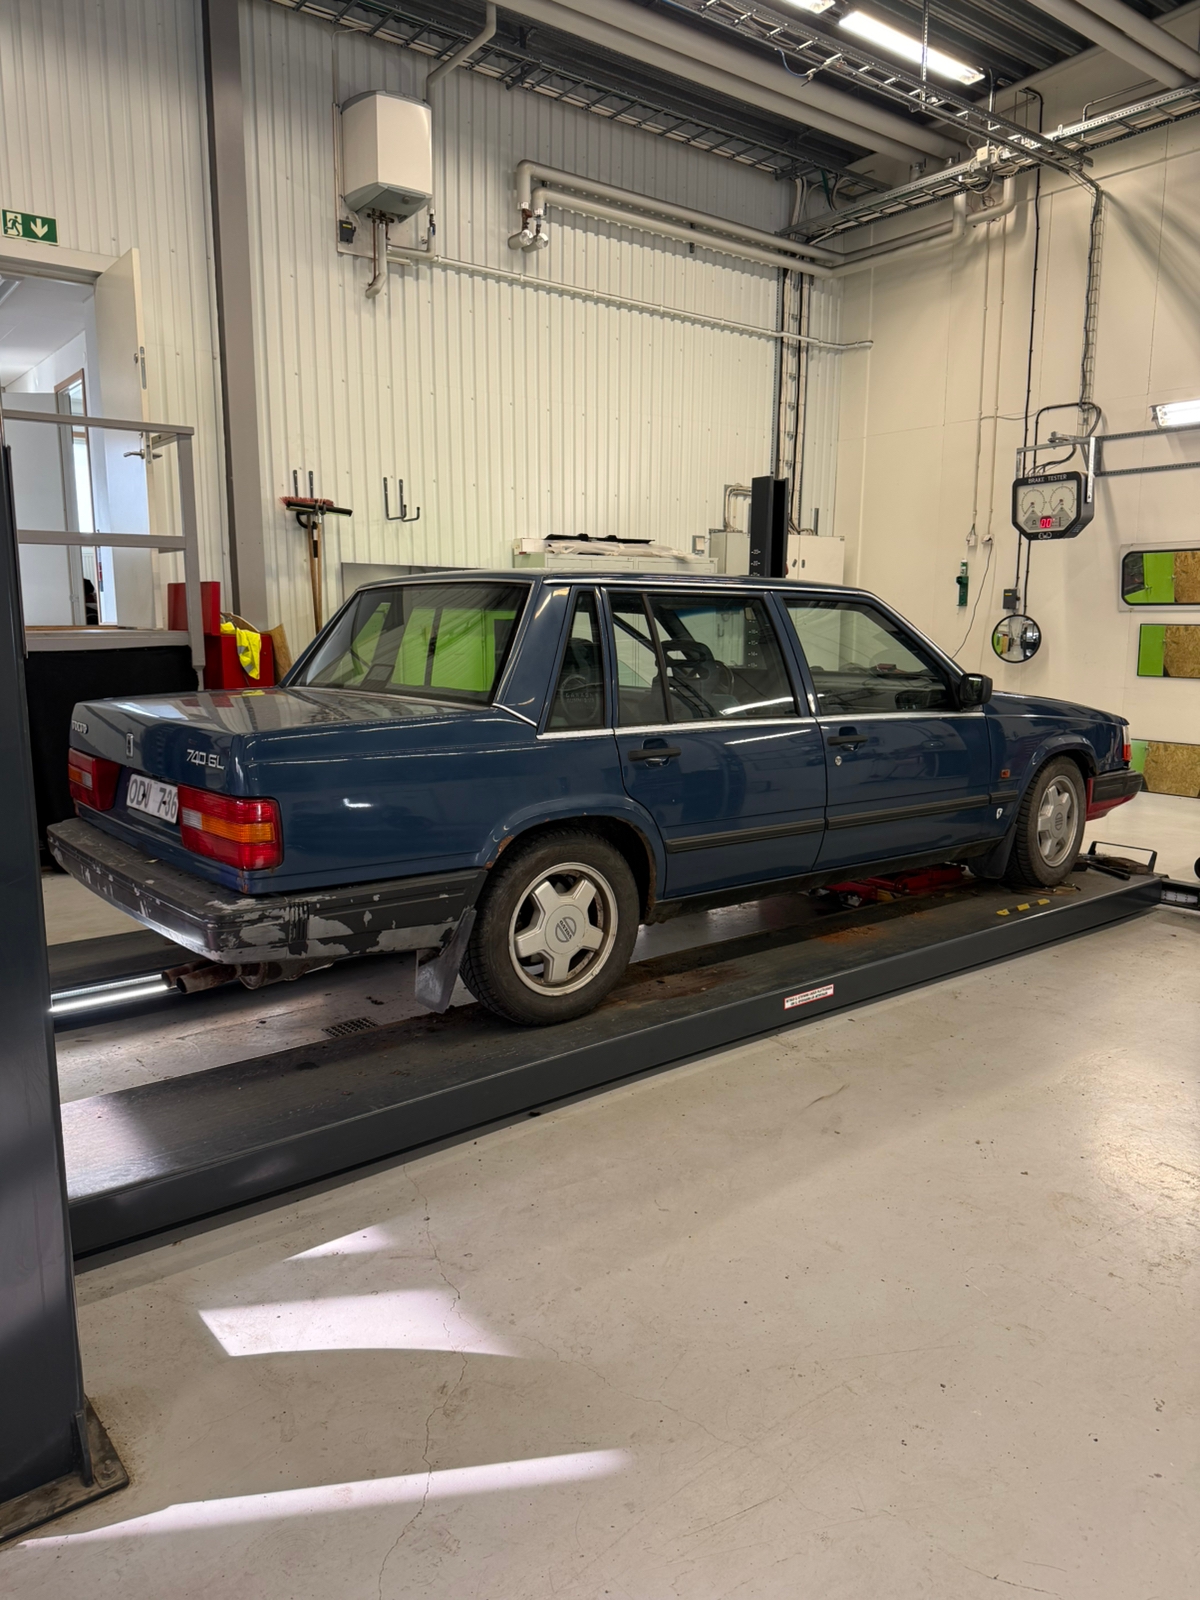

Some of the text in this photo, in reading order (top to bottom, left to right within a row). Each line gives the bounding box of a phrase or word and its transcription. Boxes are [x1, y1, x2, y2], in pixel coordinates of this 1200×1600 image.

[186, 748, 225, 771] 740 GL
[157, 787, 178, 819] 736
[559, 919, 573, 940] VOLVO
